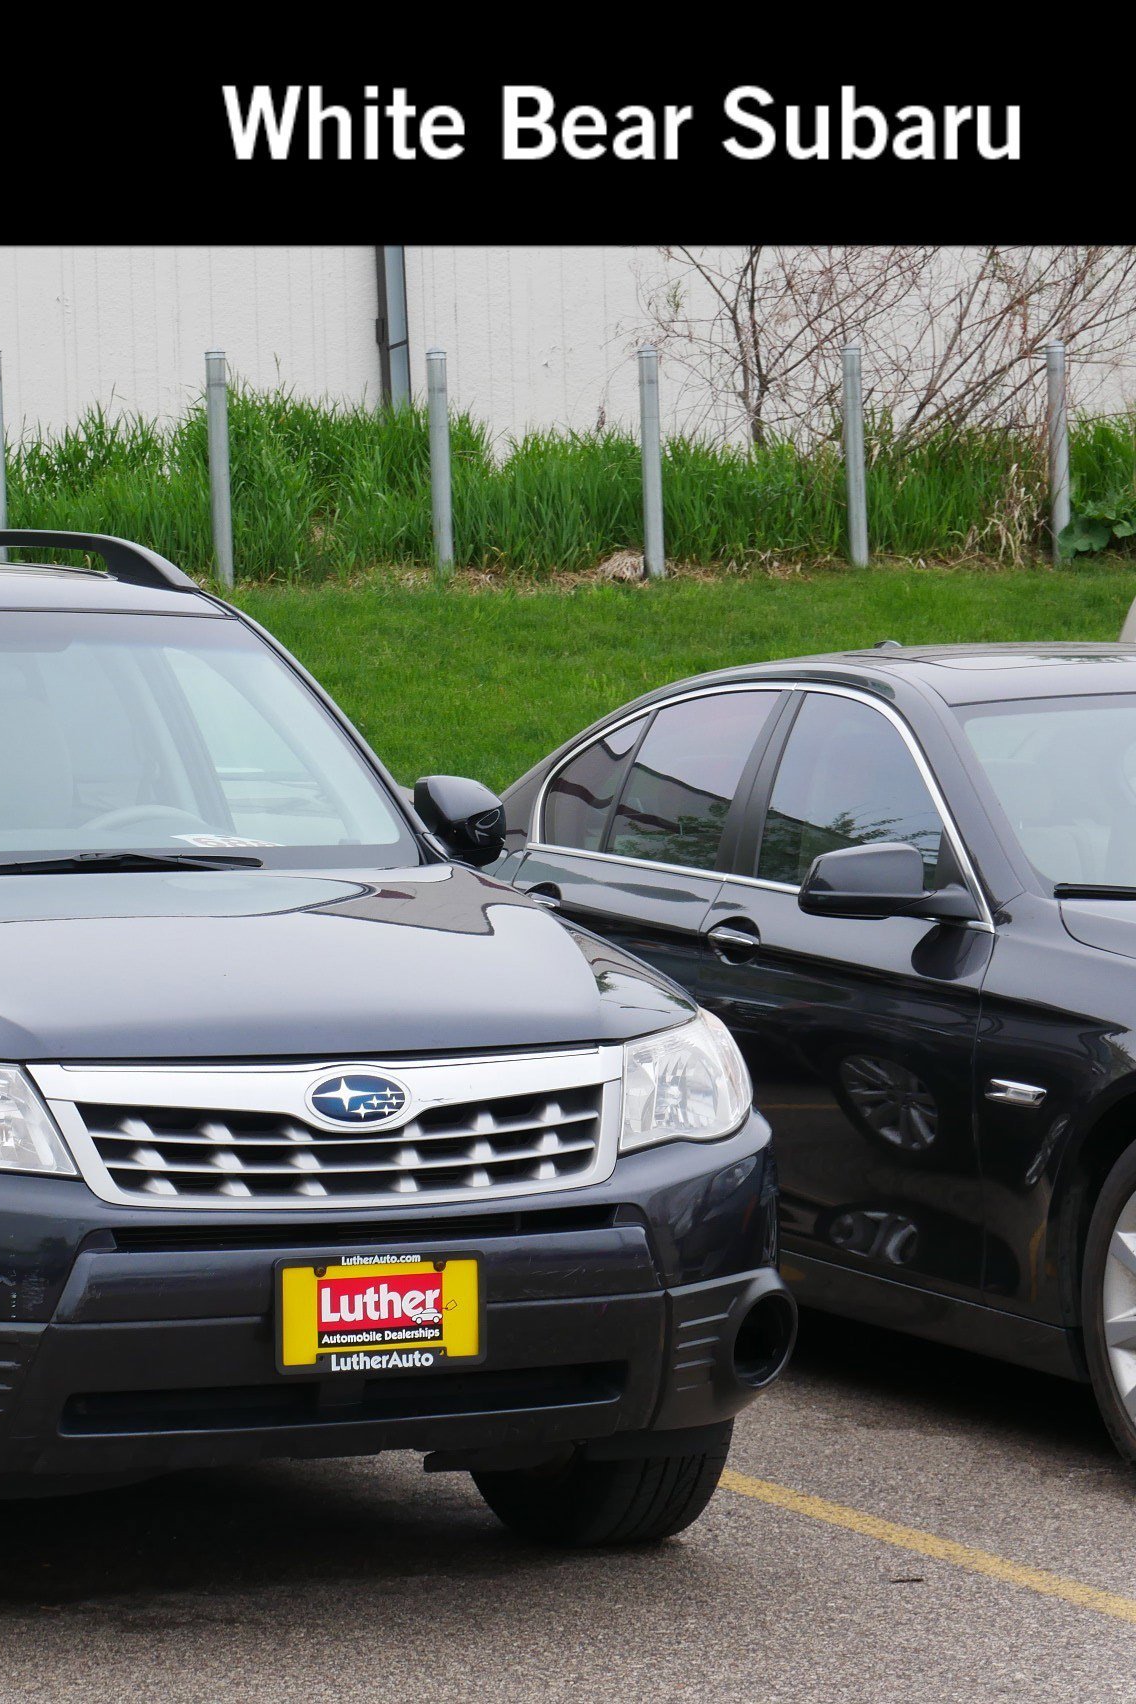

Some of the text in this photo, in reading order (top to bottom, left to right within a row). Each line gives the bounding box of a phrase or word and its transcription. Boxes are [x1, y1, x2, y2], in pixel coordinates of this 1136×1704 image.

[341, 1253, 421, 1266] LutherAuto.com
[320, 1283, 441, 1323] Luther
[321, 1327, 440, 1344] Automobile Dealerships
[330, 1350, 434, 1372] LutherAuto
